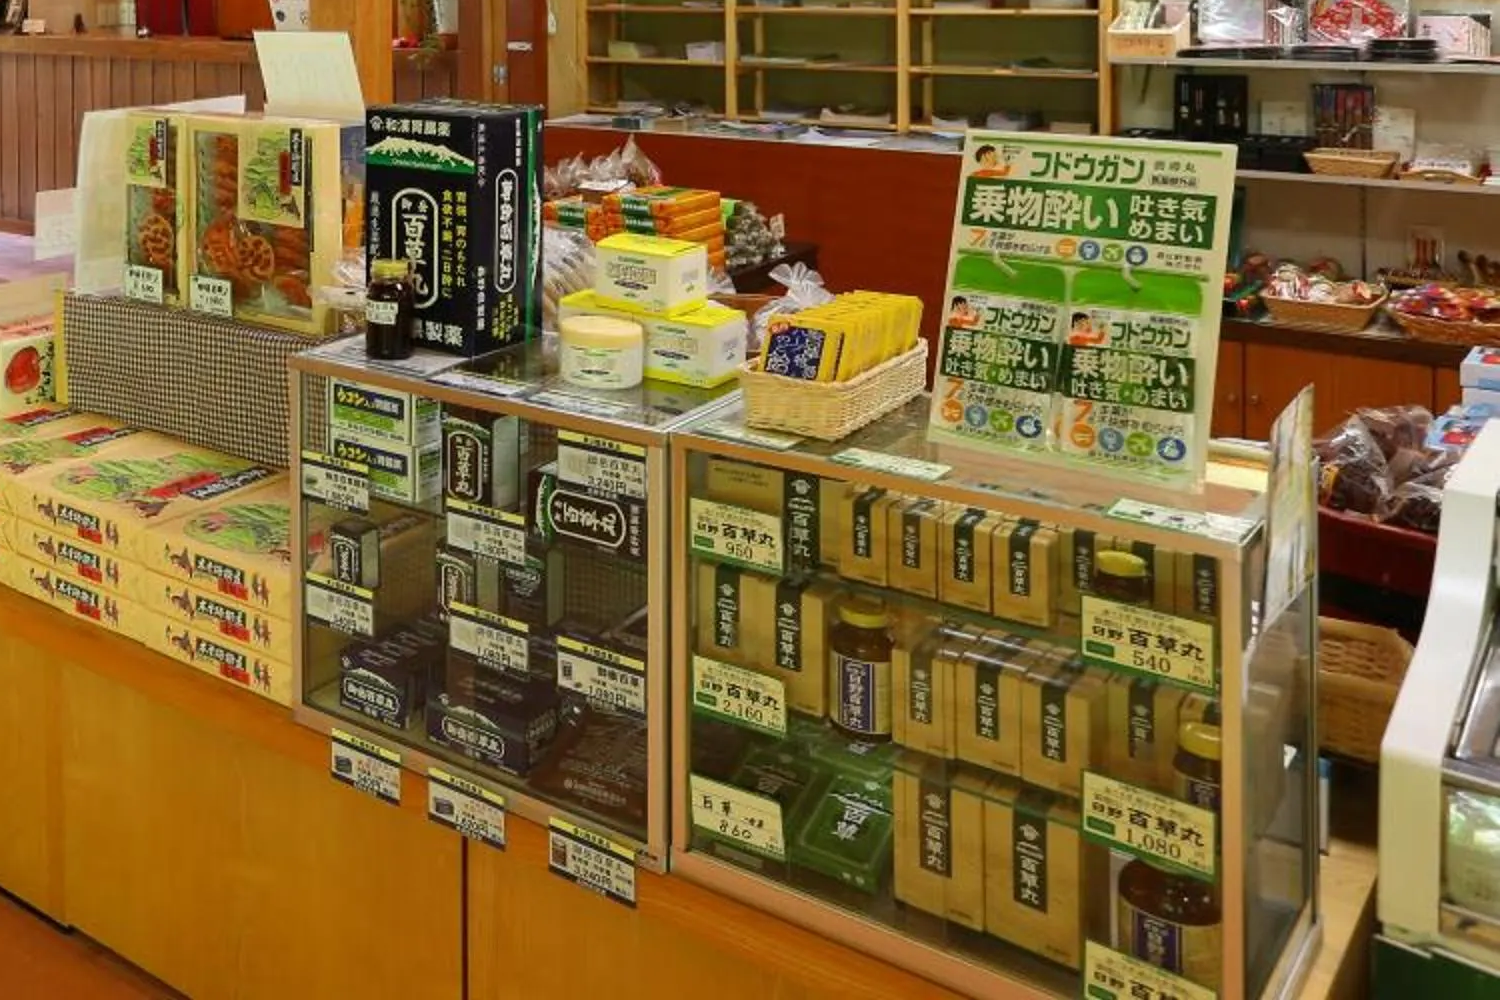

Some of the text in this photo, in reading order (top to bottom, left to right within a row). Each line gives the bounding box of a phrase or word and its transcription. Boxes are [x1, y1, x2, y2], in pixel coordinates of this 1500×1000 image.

[1030, 151, 1146, 185] フドウガン
[969, 184, 1120, 231] 乗物酔い
[1130, 195, 1208, 223] 吐き気
[1128, 221, 1204, 244] めまい
[985, 306, 1057, 335] フドウガン
[1111, 321, 1192, 350] フドウガン
[947, 329, 1049, 370] 乗物酔い
[1071, 348, 1188, 387] 乗物酔い
[1092, 625, 1206, 662] 日野百草丸
[1131, 650, 1172, 673] 540
[722, 699, 764, 723] 2,160
[1091, 801, 1205, 848] 日野百草丸
[1125, 827, 1182, 859] 1,080
